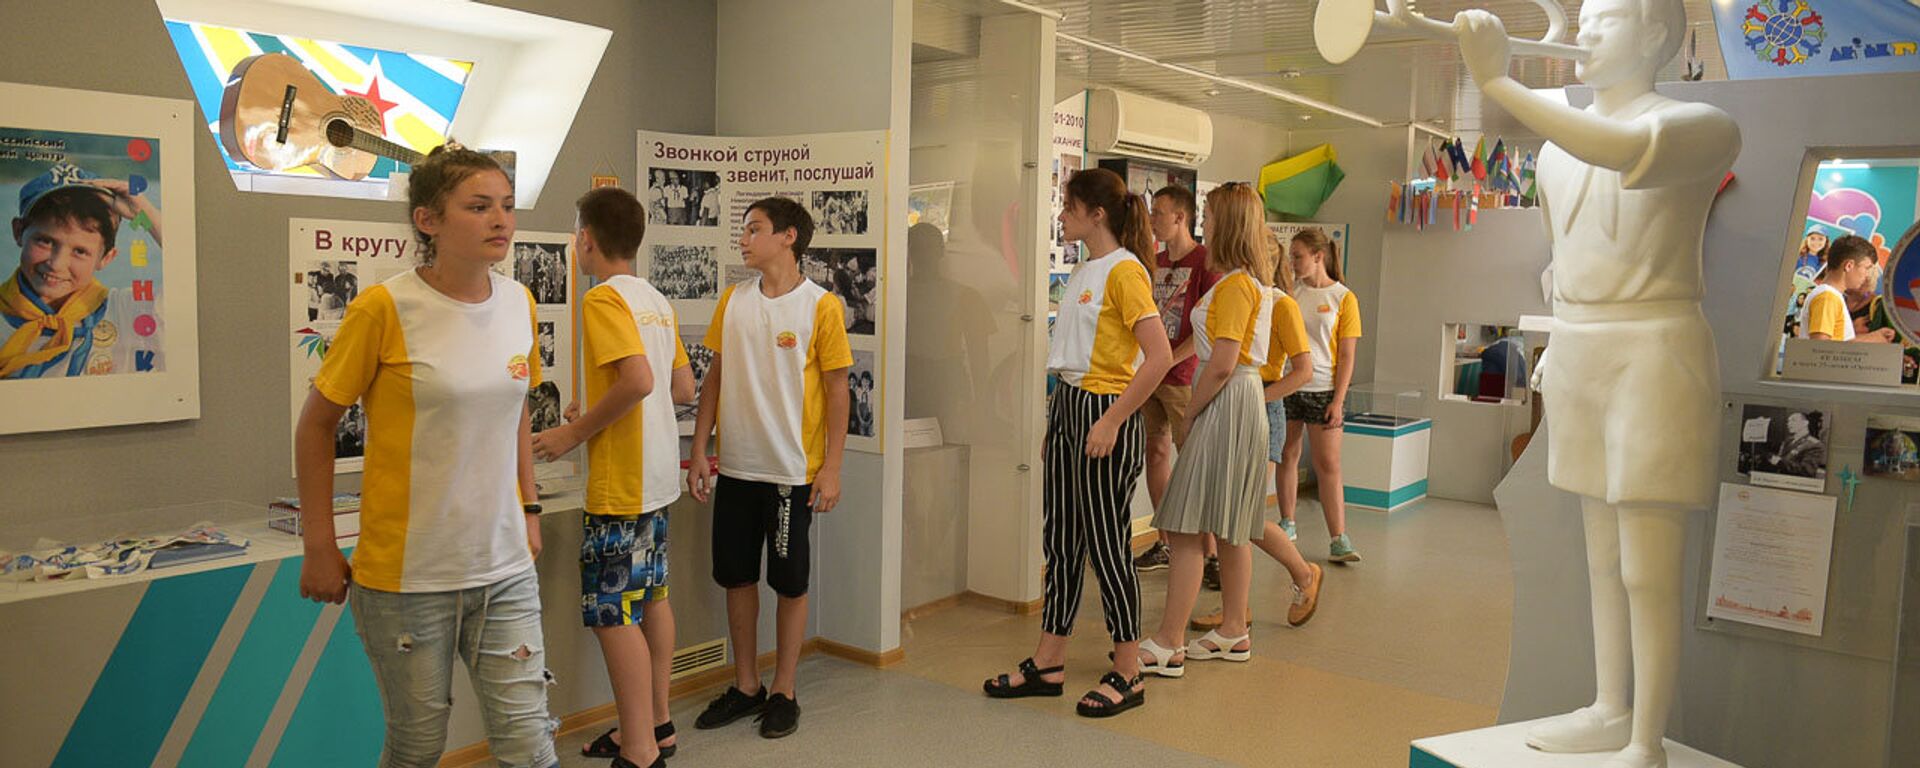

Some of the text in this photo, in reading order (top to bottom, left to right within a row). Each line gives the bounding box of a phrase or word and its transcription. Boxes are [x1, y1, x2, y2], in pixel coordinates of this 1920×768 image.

[654, 141, 810, 166] Звонкой струной
[727, 161, 874, 184] звенит, послушай
[315, 229, 333, 250] В
[342, 235, 407, 258] кругу
